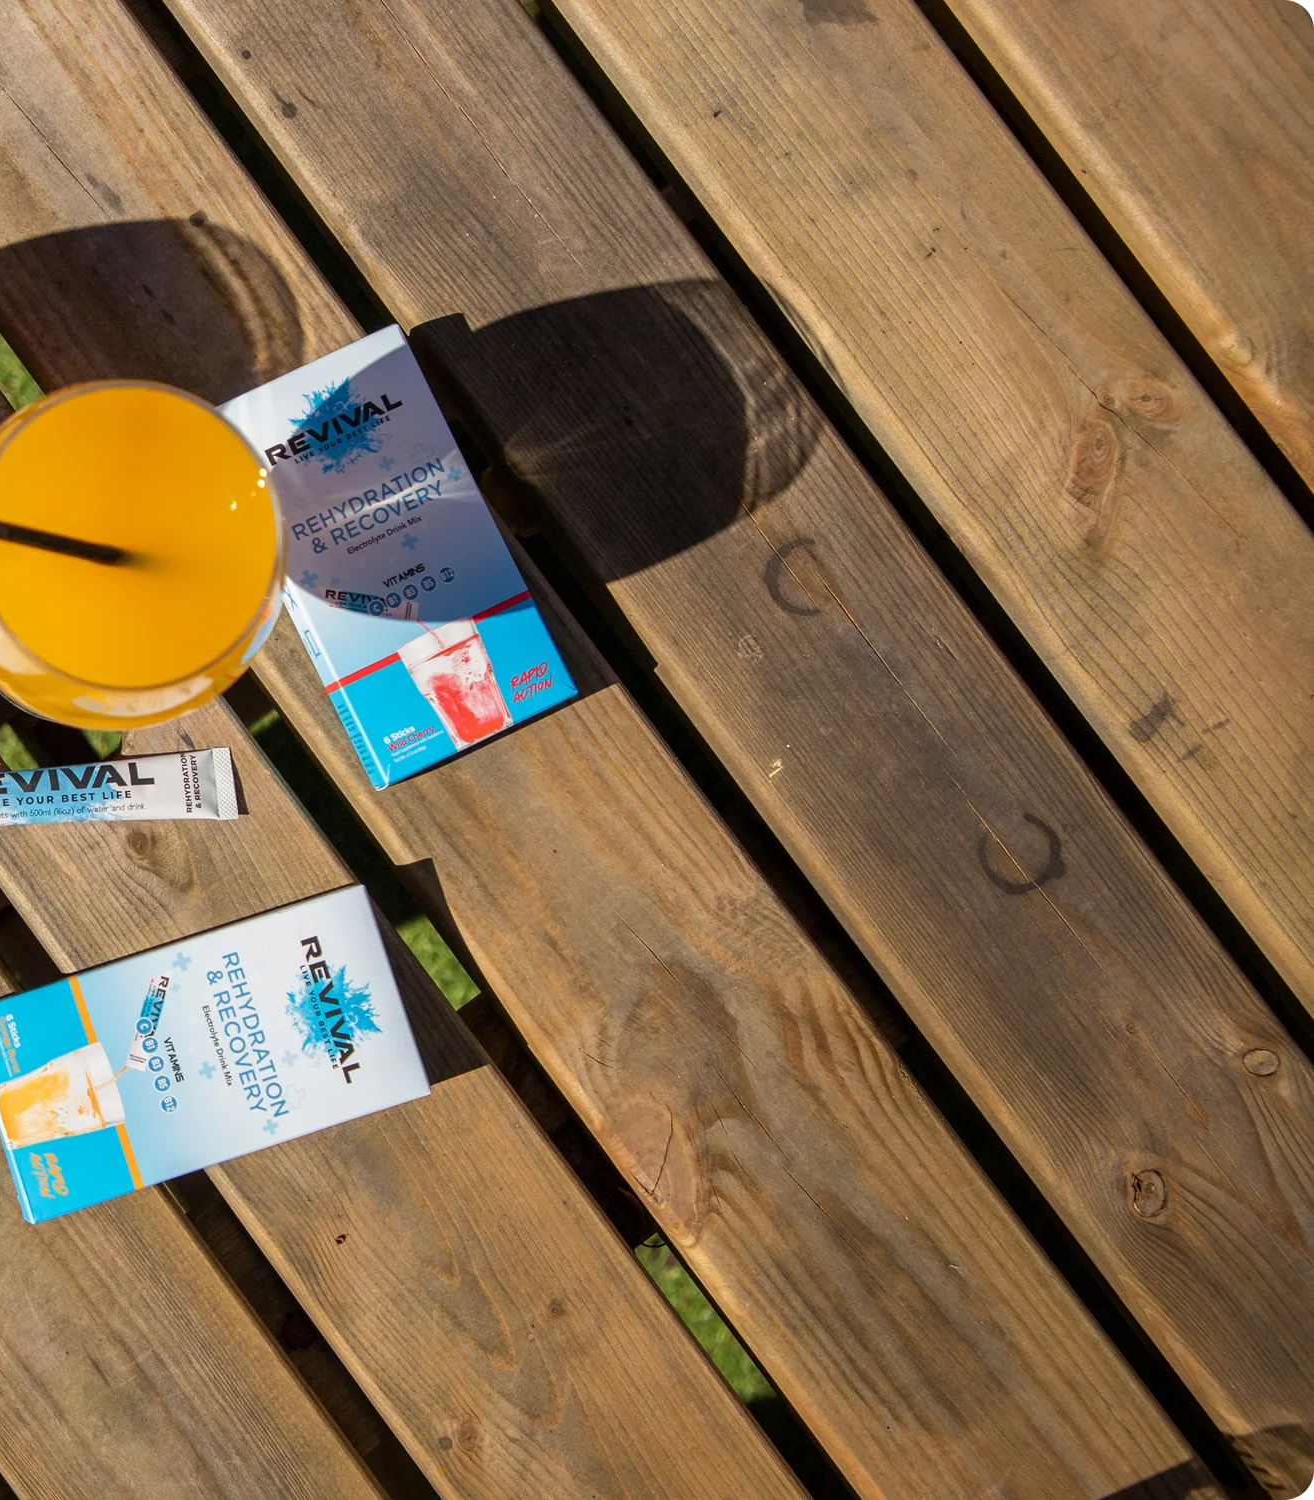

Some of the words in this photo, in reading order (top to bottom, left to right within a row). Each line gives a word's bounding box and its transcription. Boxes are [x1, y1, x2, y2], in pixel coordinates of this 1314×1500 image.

[264, 394, 403, 466] REVIVAL
[294, 450, 316, 464] LIVE
[318, 438, 343, 454] YOUR
[346, 426, 368, 440] BEST
[371, 415, 391, 428] LIFE
[291, 457, 445, 541] REHYDRATION
[312, 537, 328, 554] &
[329, 479, 442, 546] RECOVERY
[347, 532, 386, 555] Electrolyte
[386, 522, 408, 537] Drink
[408, 515, 423, 527] Mix
[382, 563, 426, 588] VITAMINS
[388, 595, 399, 605] B1
[405, 587, 416, 598] B3
[423, 578, 435, 589] B5
[439, 568, 455, 581] B12
[510, 661, 548, 690] RAPID
[513, 672, 553, 703] ACTION
[383, 736, 391, 744] 6
[390, 726, 416, 741] Sticks
[388, 738, 407, 751] Wild
[407, 726, 434, 743] Cherry
[16, 795, 55, 806] YOUR
[61, 792, 95, 803] BEST
[102, 790, 132, 800] LIFE
[180, 753, 193, 813] REHYDRATION
[189, 754, 201, 801] RECOVERY
[10, 810, 28, 818] with
[29, 808, 52, 817] 500ml
[53, 807, 74, 817] (16oz)
[76, 806, 87, 814] of
[87, 805, 109, 814] water
[111, 803, 126, 812] and
[127, 802, 146, 811] drink
[206, 970, 223, 985] &
[299, 964, 312, 987] LIVE
[308, 990, 321, 1017] YOUR
[318, 1020, 331, 1044] BEST
[327, 1048, 339, 1070] LIFE
[300, 935, 361, 1084] REVIVAL
[8, 1021, 21, 1048] Sticks
[202, 1004, 220, 1048] Electrolyte
[216, 1048, 226, 1071] Drink
[223, 1071, 233, 1087] Mix
[213, 990, 267, 1113] RECOVERY
[222, 951, 289, 1118] REHYDRATION
[145, 1039, 155, 1050] B1
[151, 1058, 162, 1069] B3
[157, 1077, 168, 1089] B5
[164, 1096, 175, 1112] B12
[163, 1037, 184, 1083] VITAMINS
[29, 1152, 57, 1199] ACTION
[42, 1152, 69, 1197] RAPID
